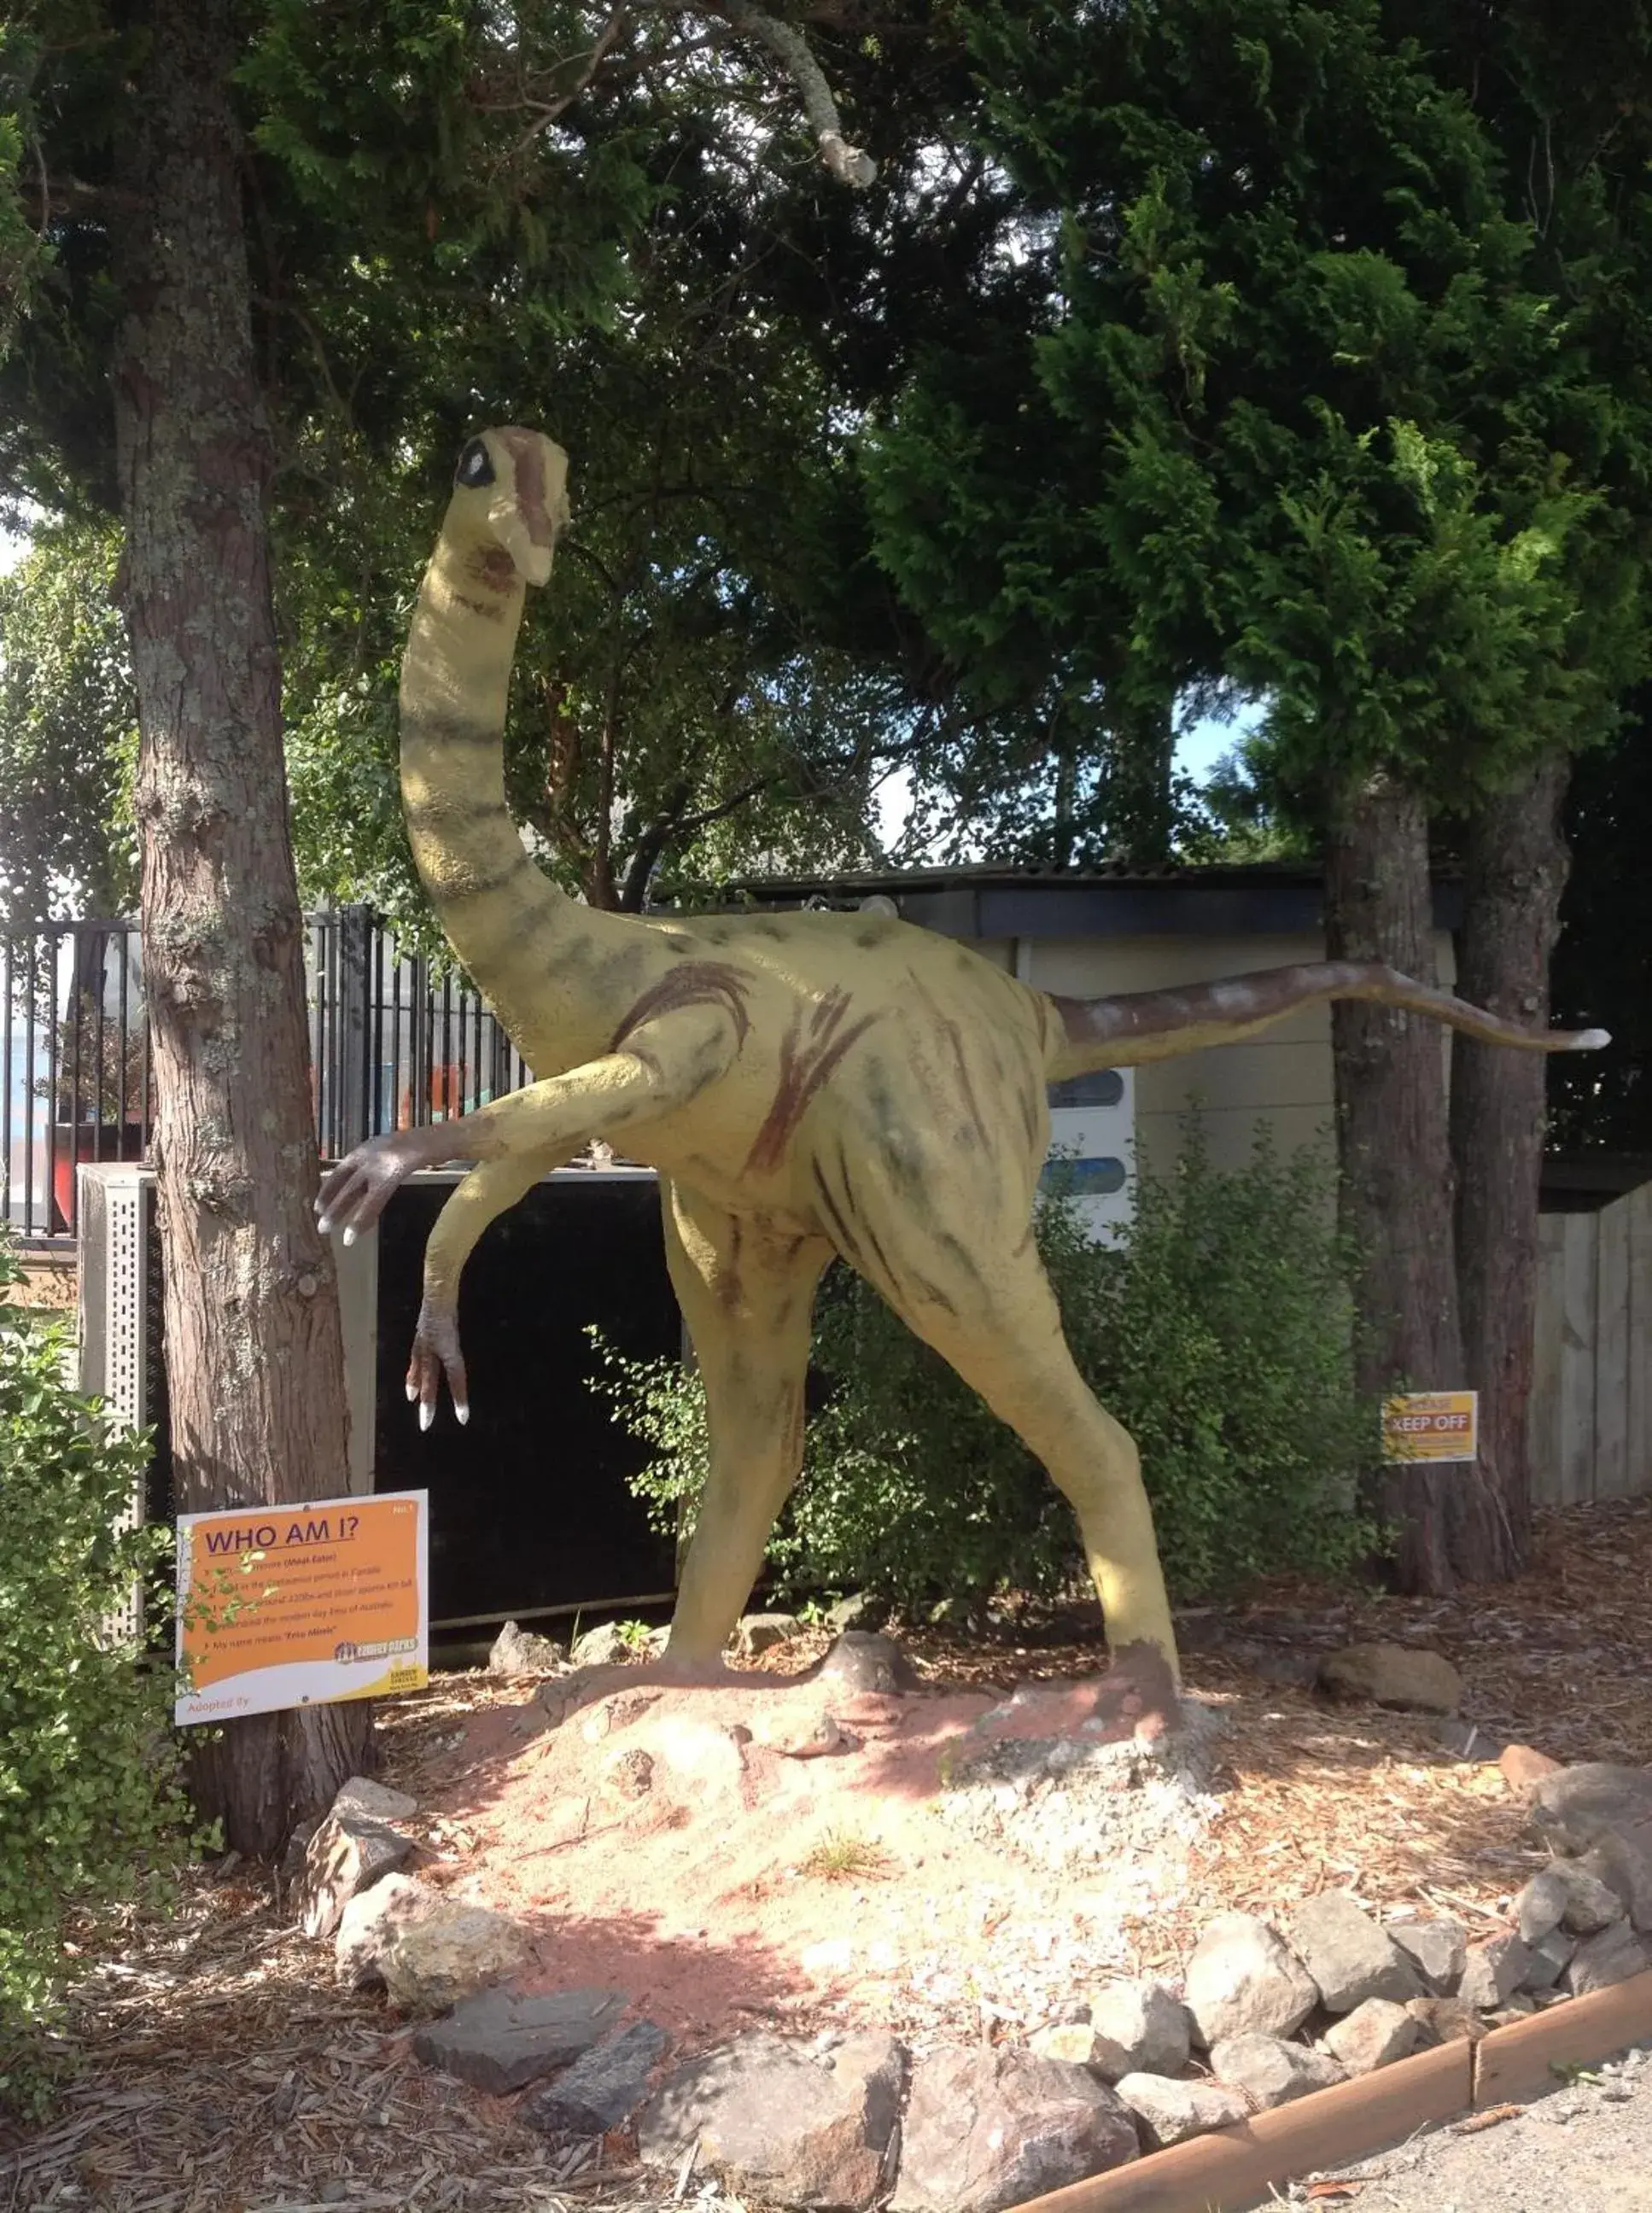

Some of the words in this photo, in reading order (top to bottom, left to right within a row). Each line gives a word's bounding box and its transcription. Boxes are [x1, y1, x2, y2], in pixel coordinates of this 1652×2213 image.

[1392, 1416, 1431, 1432] KEEP
[1434, 1414, 1468, 1431] OFF
[206, 1526, 277, 1553] WHO
[285, 1520, 330, 1544] AM
[339, 1515, 359, 1538] I?
